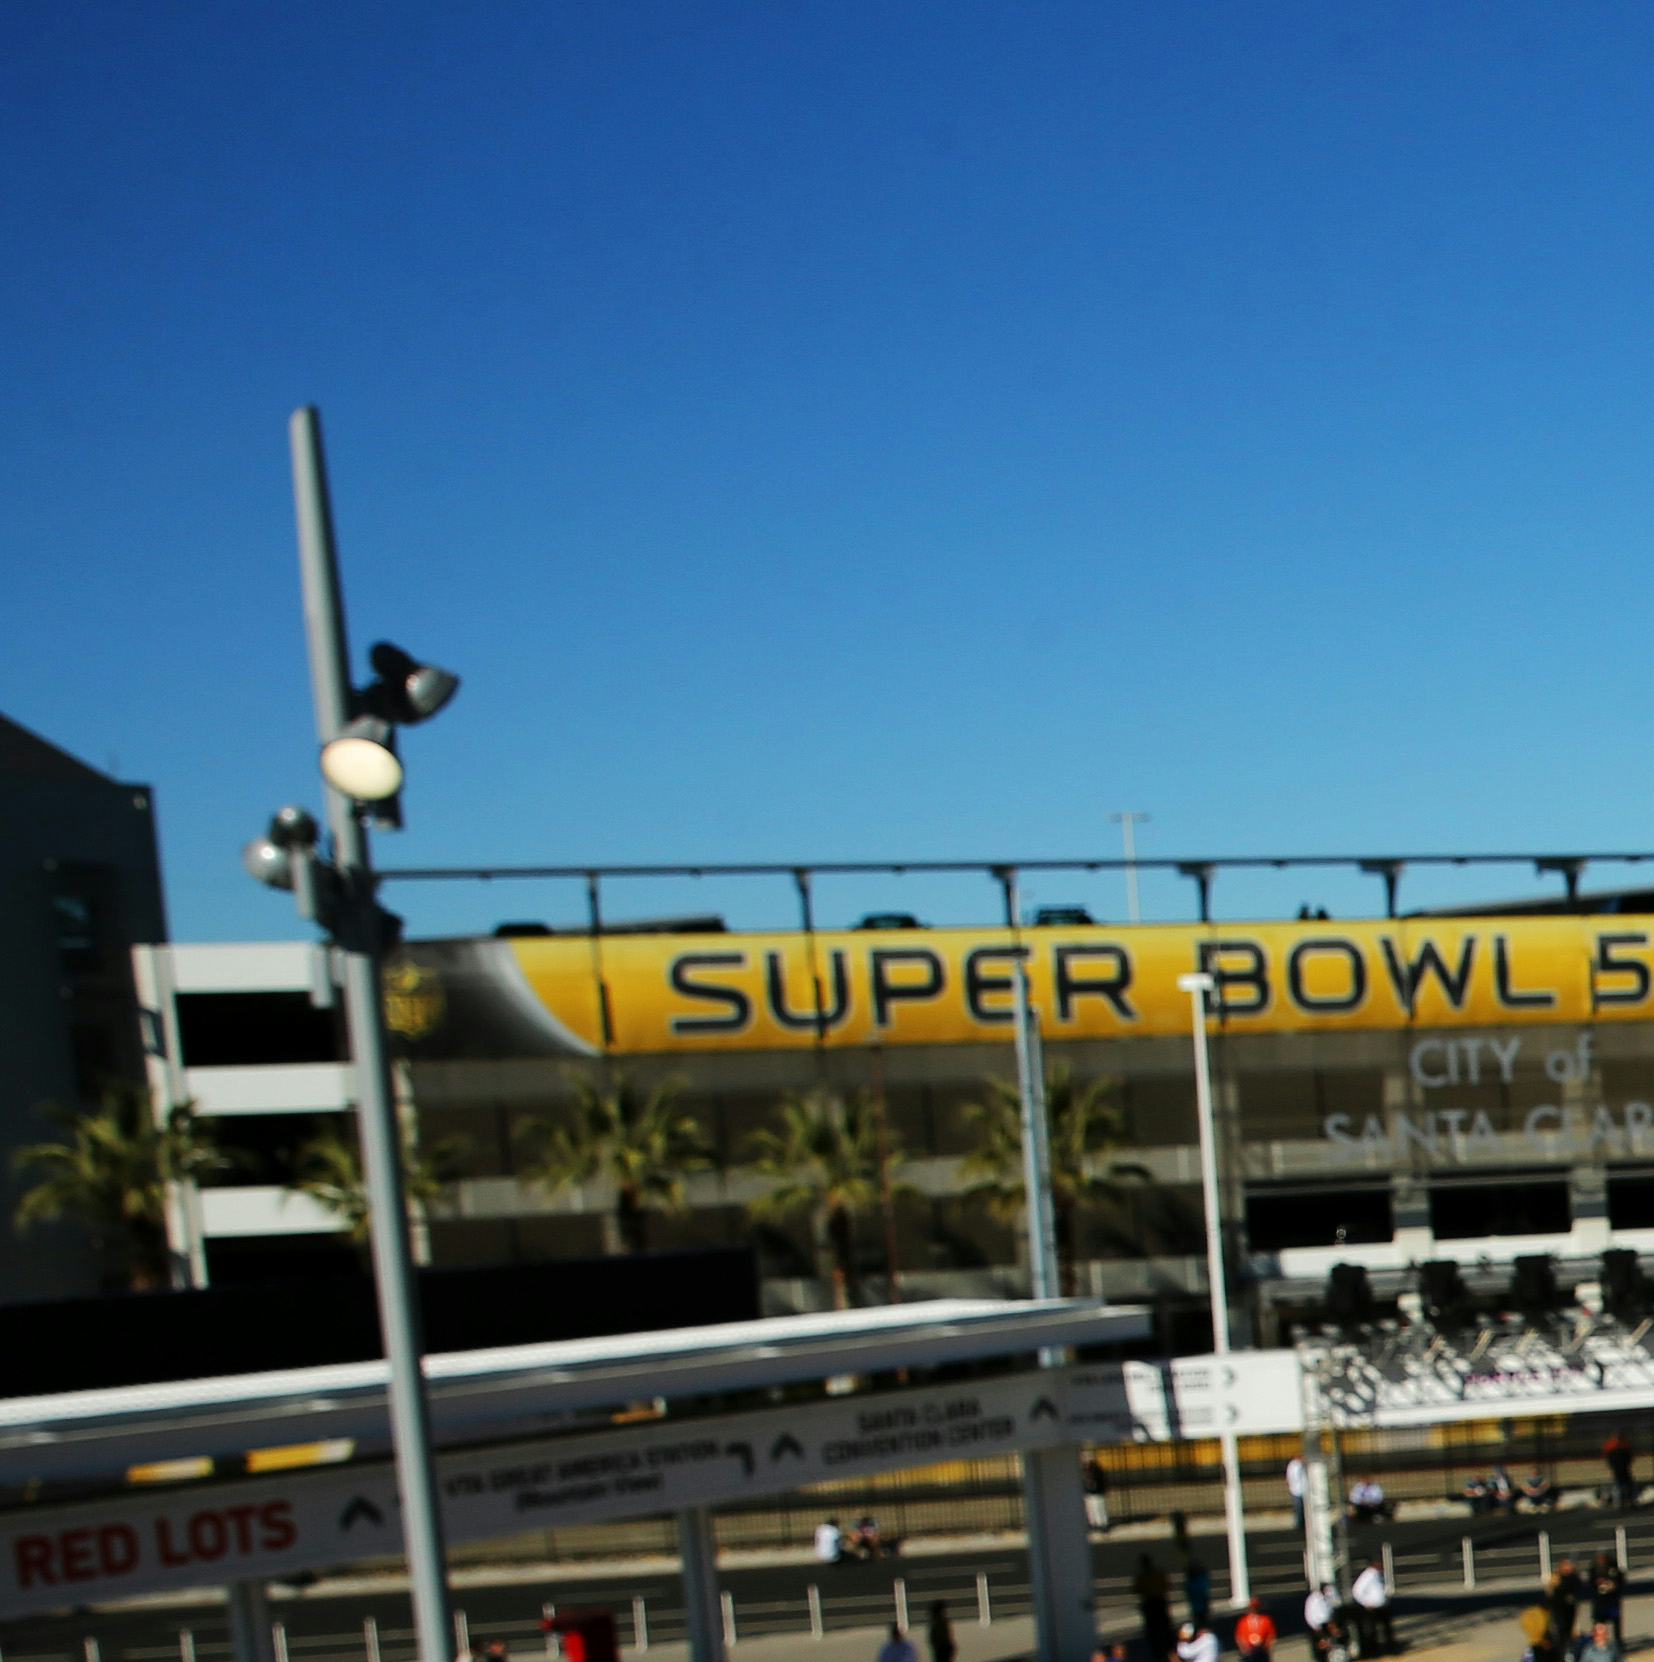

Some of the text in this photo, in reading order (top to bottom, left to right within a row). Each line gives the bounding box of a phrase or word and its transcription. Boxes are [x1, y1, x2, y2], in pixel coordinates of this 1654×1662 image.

[670, 944, 1137, 1034] SUPER
[1200, 935, 1555, 1016] BOWL
[1410, 1031, 1595, 1088] CITY of
[1323, 1107, 1499, 1166] SANTA
[15, 1502, 297, 1591] RED LOTS
